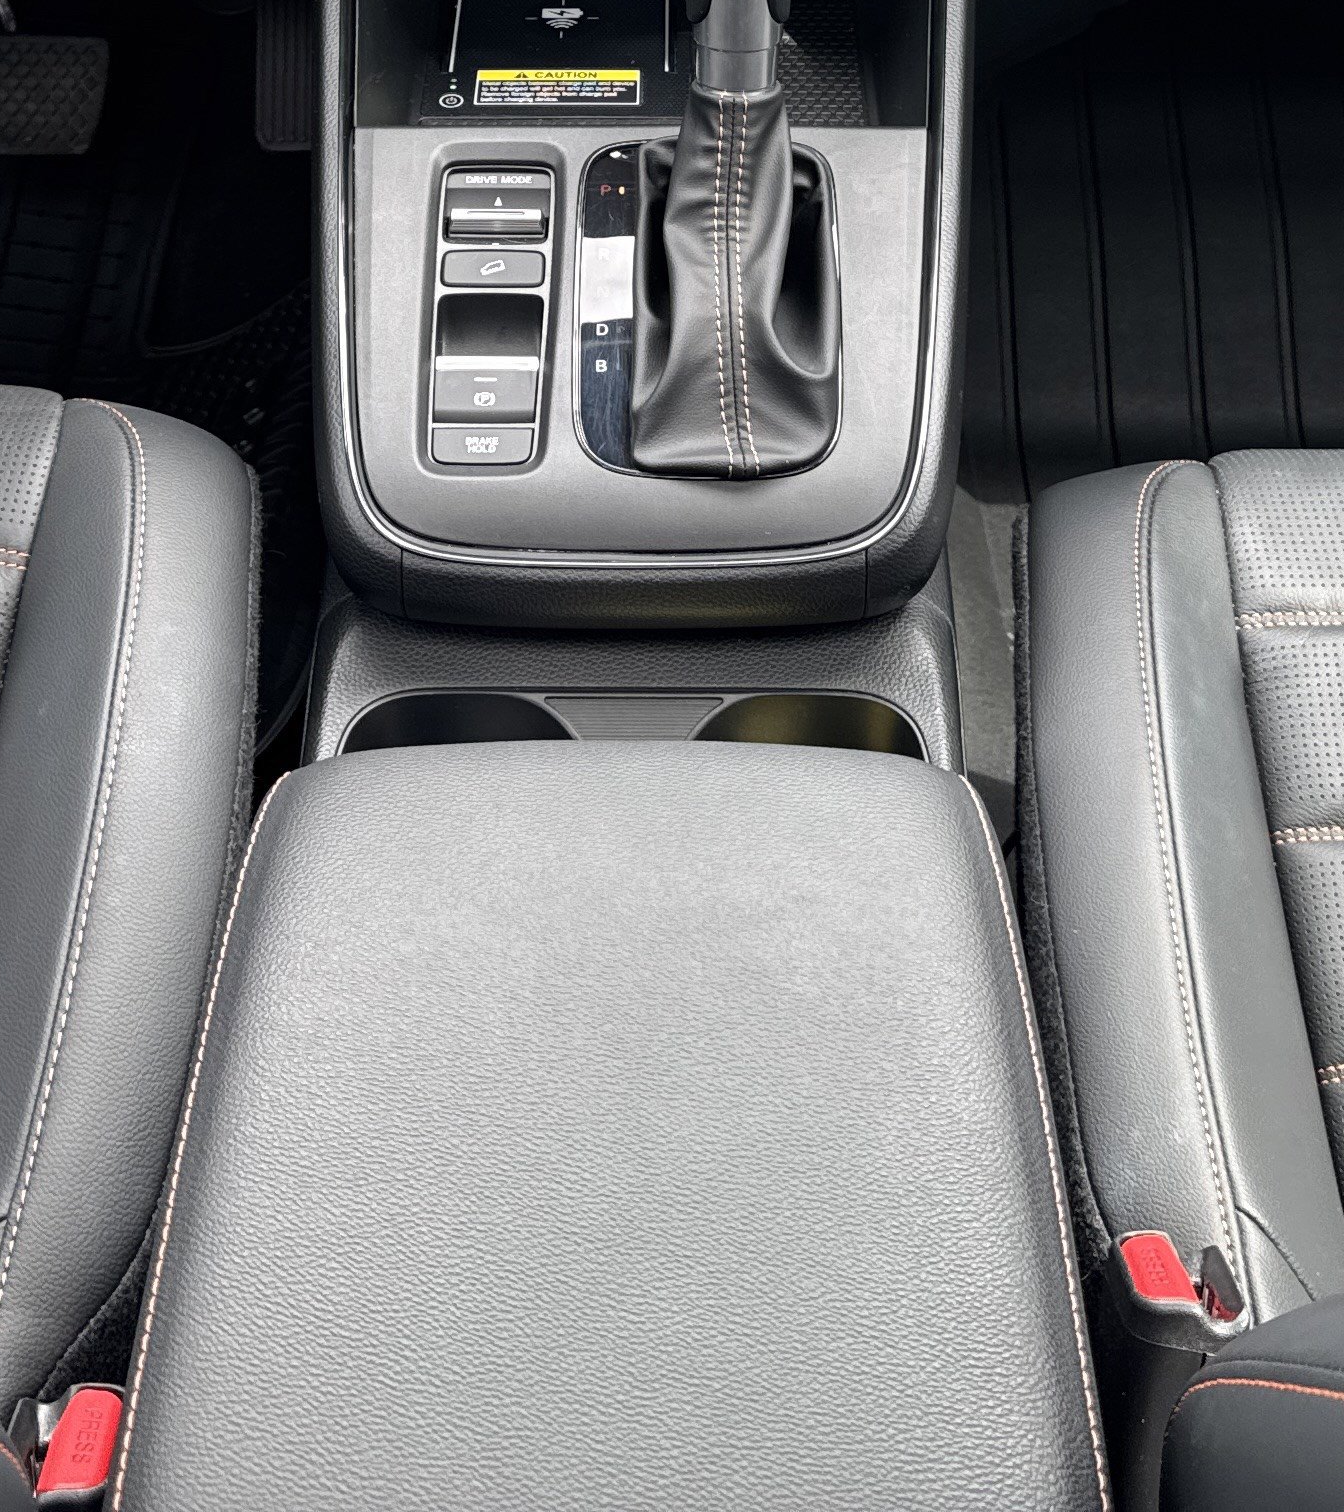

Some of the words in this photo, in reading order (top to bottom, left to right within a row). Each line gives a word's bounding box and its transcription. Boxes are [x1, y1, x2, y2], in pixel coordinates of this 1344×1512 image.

[534, 71, 598, 79] CAUTION
[465, 175, 497, 184] DRIVE
[500, 175, 533, 184] MODE
[600, 183, 612, 197] P
[595, 322, 609, 336] D
[595, 358, 608, 373] B
[465, 436, 499, 445] BRAKE
[467, 444, 497, 454] HOLD
[71, 1407, 104, 1465] PRESS
